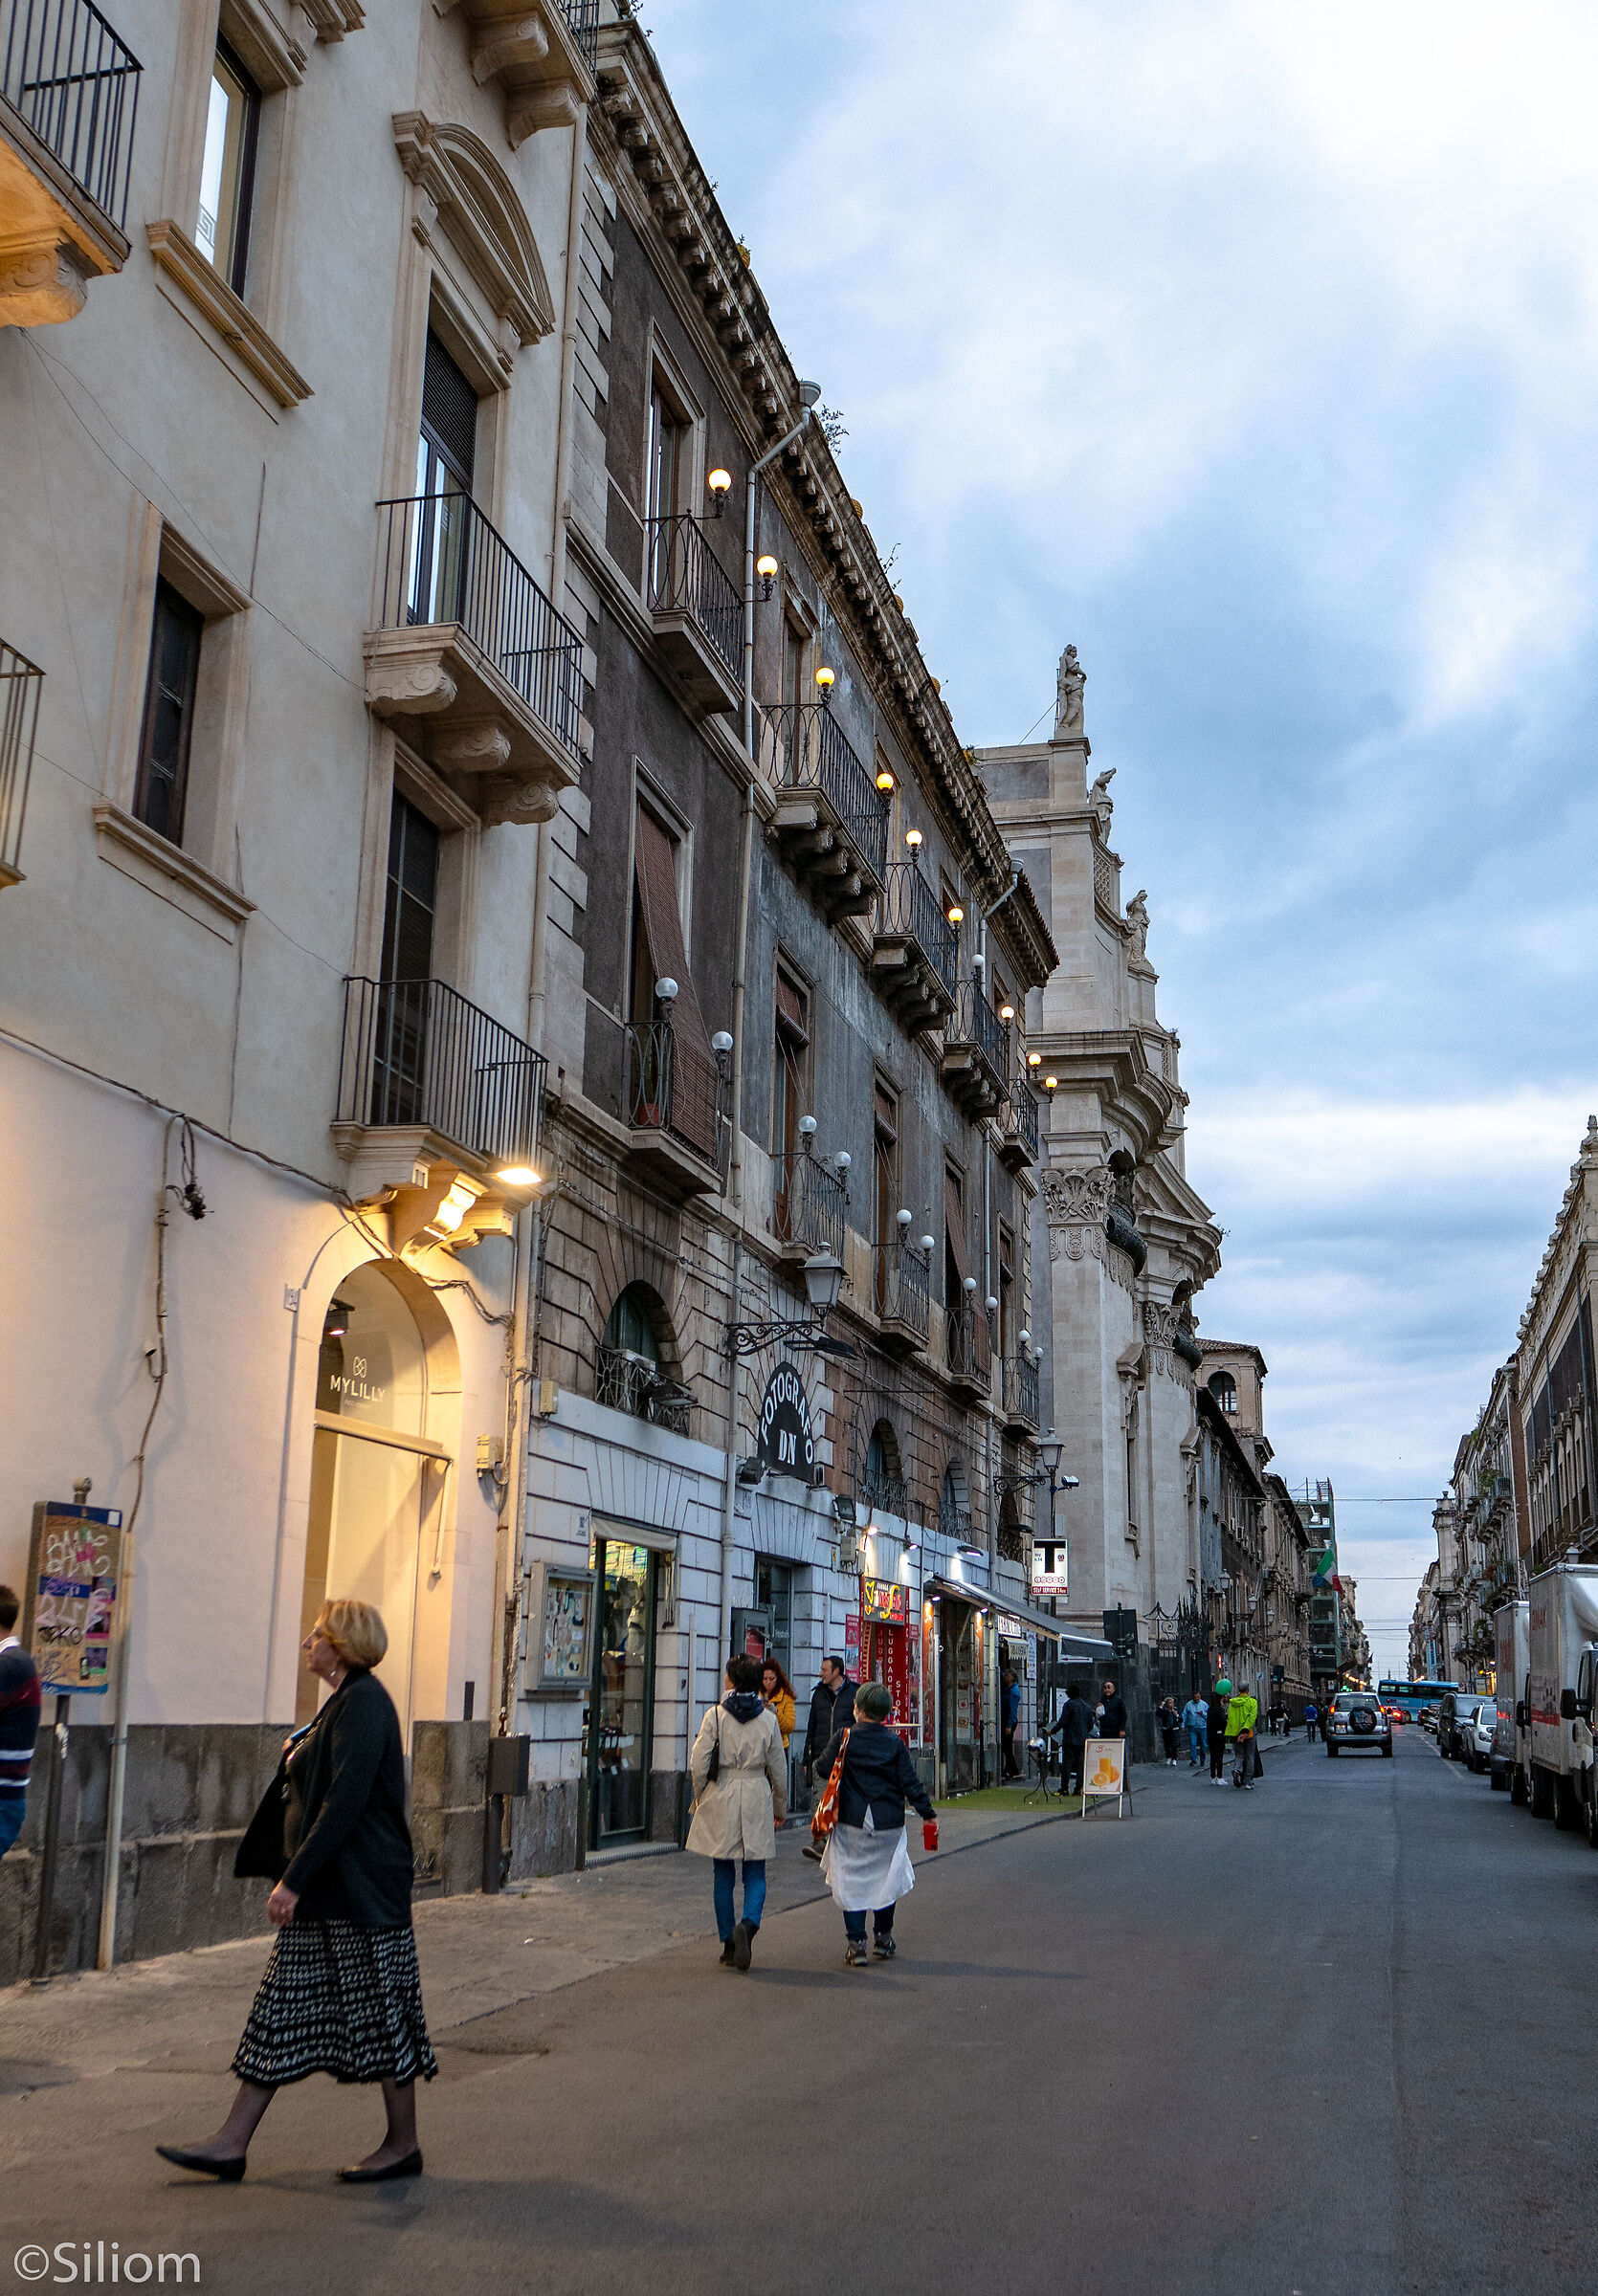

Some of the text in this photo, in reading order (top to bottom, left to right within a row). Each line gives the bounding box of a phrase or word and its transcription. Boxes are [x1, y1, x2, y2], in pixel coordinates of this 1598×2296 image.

[329, 1374, 386, 1402] MYLILLY
[761, 1371, 813, 1465] FOTOGRAFO
[778, 1429, 796, 1466] DN
[1033, 1540, 1066, 1573] T
